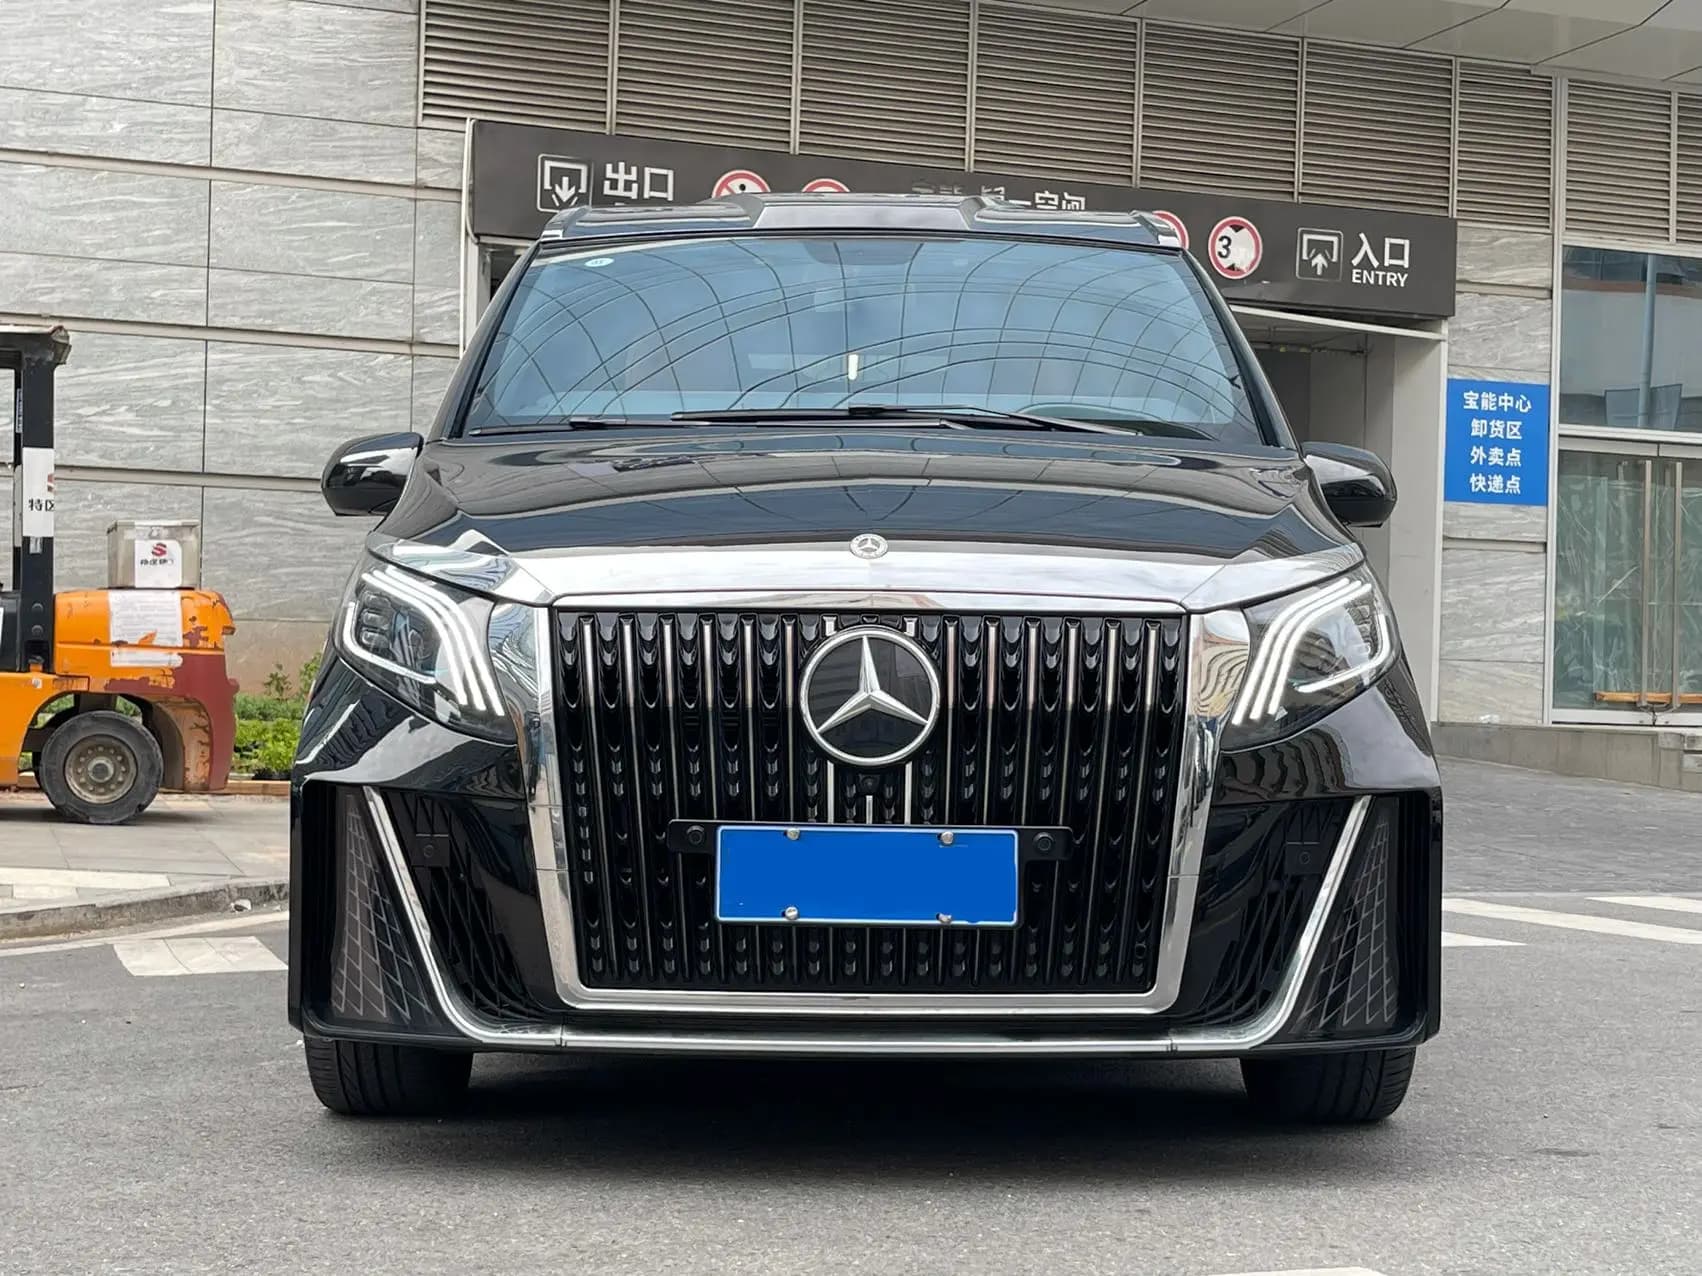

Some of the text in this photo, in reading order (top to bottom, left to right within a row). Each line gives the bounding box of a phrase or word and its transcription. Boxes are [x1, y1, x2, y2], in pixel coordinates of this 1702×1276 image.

[603, 162, 674, 202] 出口
[1351, 233, 1410, 268] 入口
[1352, 268, 1409, 288] ENTRY
[1463, 390, 1532, 413] 宝能中心
[1470, 418, 1522, 440] 卸货区
[1470, 445, 1522, 467] 外卖点
[1469, 472, 1521, 494] 快递点
